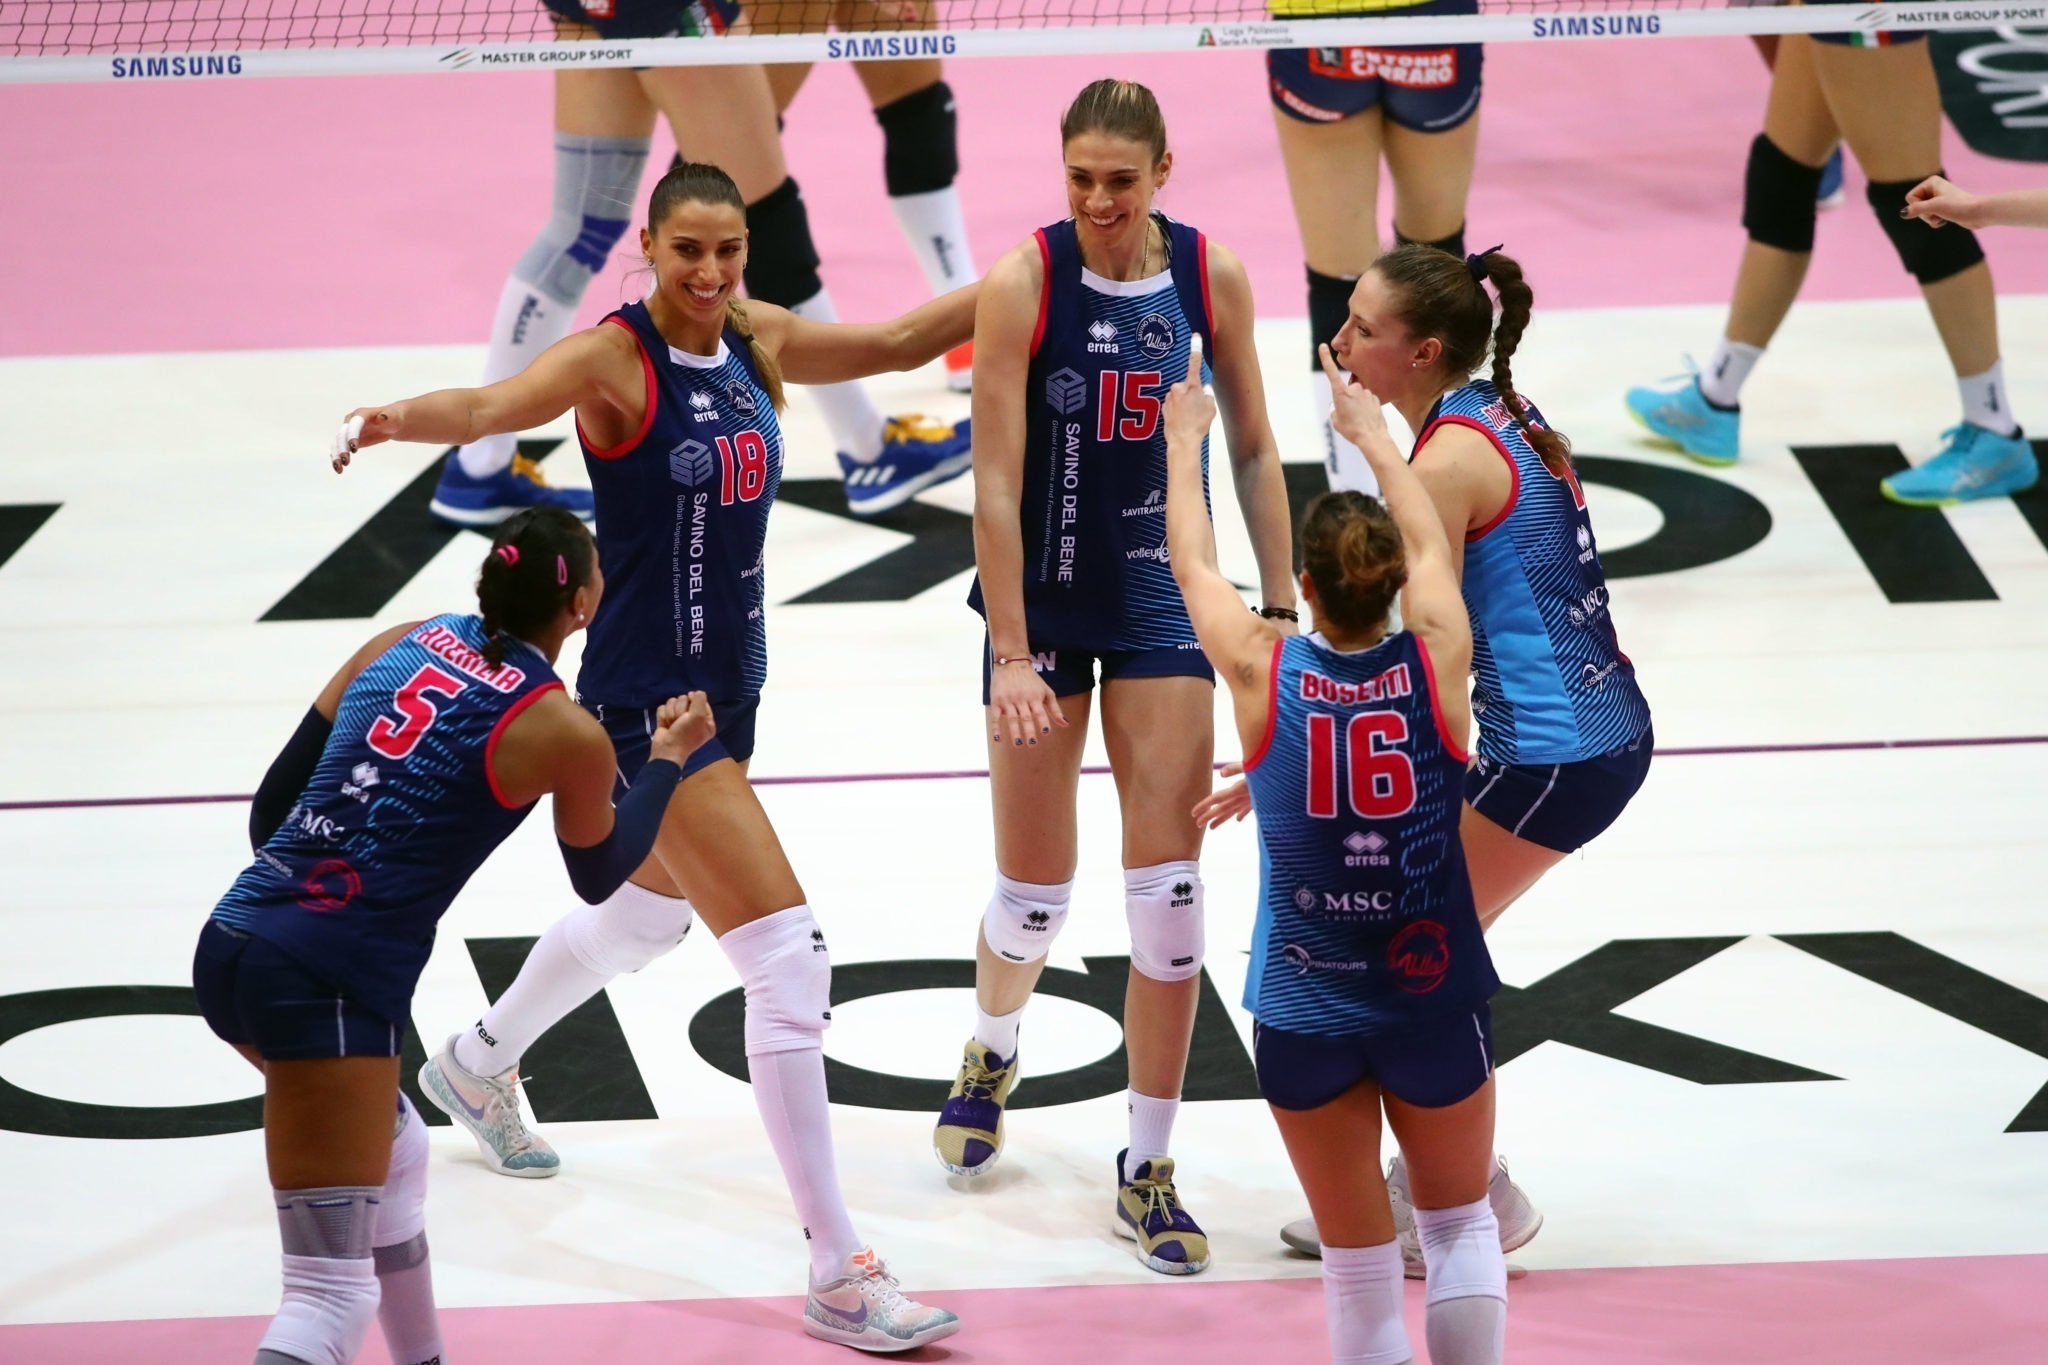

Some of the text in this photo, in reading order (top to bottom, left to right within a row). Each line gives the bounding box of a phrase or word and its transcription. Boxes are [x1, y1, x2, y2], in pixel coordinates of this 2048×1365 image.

[1533, 15, 1661, 38] SAMSUNG
[1896, 8, 2046, 22] MASTER GROUP SPORT
[482, 48, 633, 64] MASTER GROUP SPORT
[827, 35, 956, 59] SAMSUNG
[1350, 48, 1453, 68] ANTONIO
[111, 54, 243, 78] SAMSUNG
[1087, 341, 1119, 354] errea
[693, 410, 720, 423] errea
[1097, 370, 1162, 442] 15
[1051, 419, 1059, 445] Global
[714, 429, 768, 506] 18
[676, 494, 686, 520] Global
[1057, 422, 1081, 582] SAVINO DEL BENE
[688, 492, 708, 655] SAVINO DEL BENE
[1300, 662, 1412, 706] BOSETTI
[366, 662, 469, 761] 5
[1306, 710, 1418, 820] 16
[1344, 854, 1391, 867] errea
[1171, 897, 1194, 908] errea
[1323, 890, 1393, 912] MSC
[1022, 923, 1048, 932] errea
